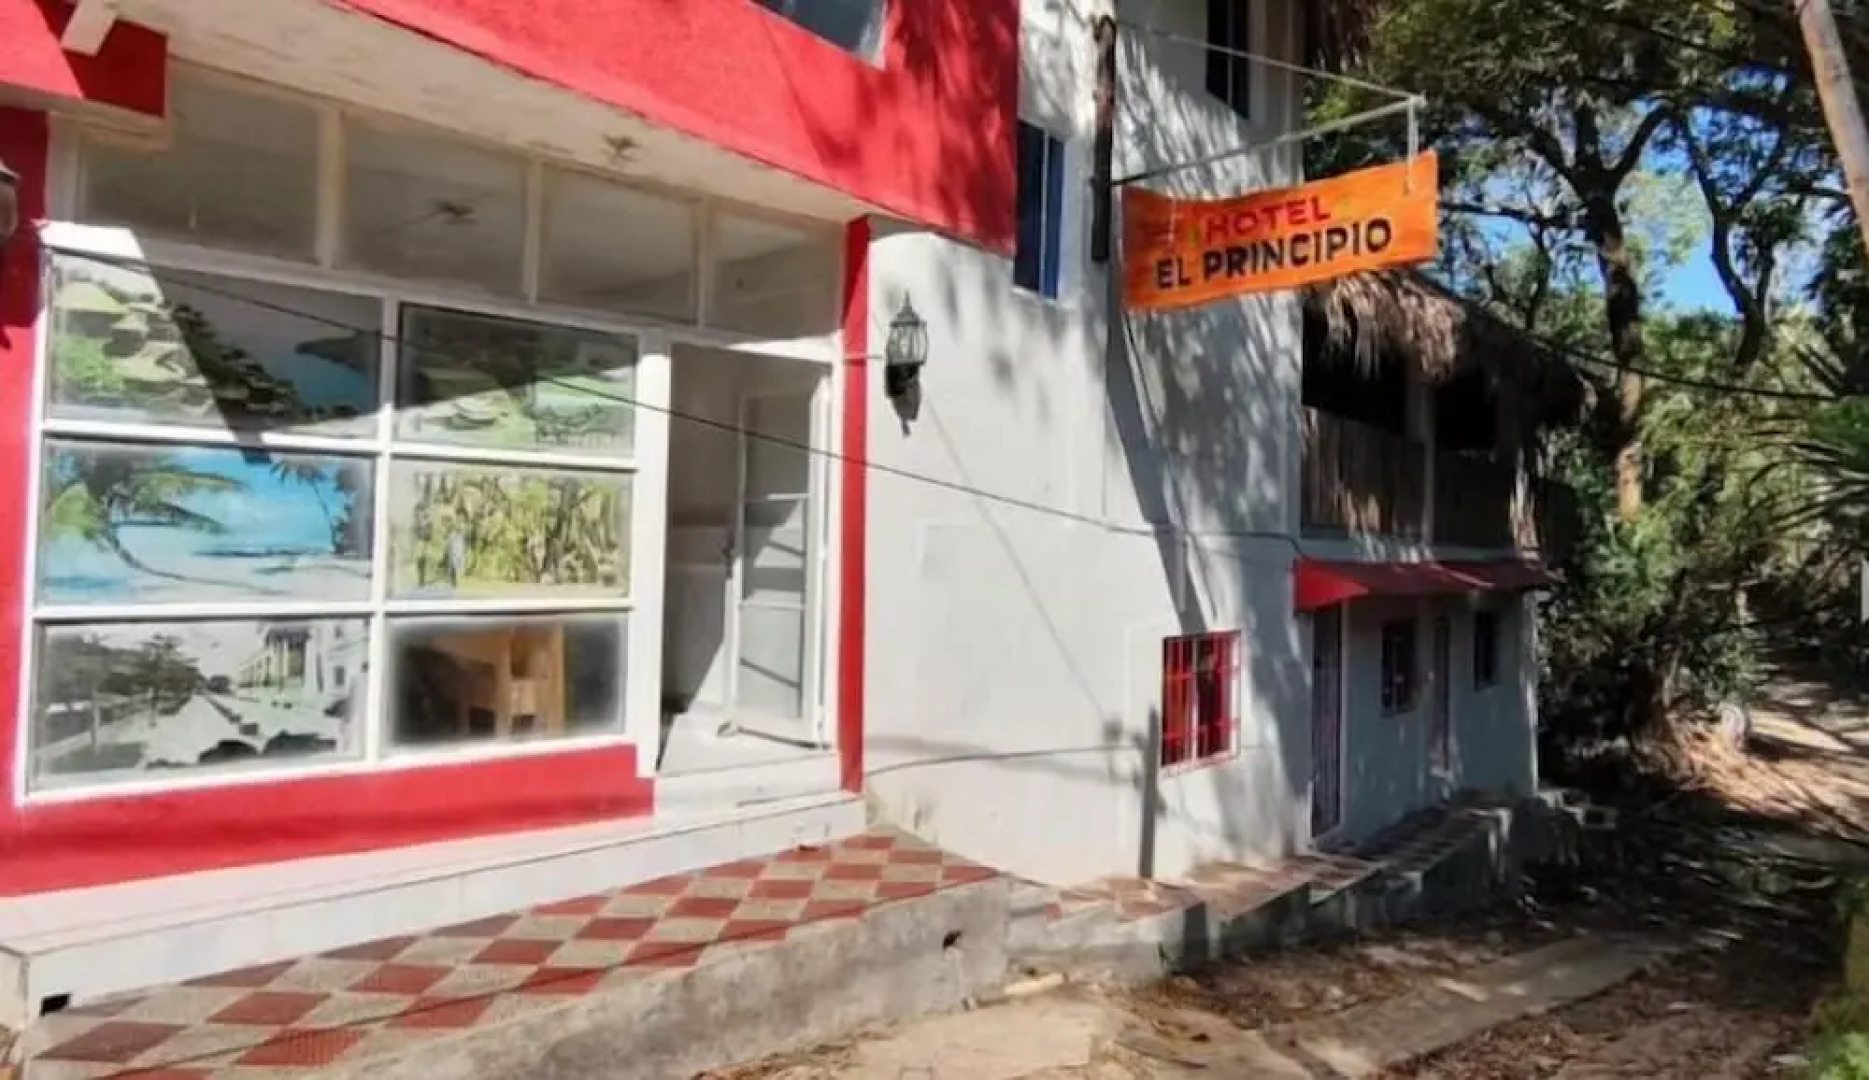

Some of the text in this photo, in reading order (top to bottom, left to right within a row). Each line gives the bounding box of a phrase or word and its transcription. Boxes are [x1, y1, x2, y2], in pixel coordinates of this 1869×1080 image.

[1206, 197, 1331, 241] HOTEL
[1156, 218, 1392, 289] EL PRINCIPIO
